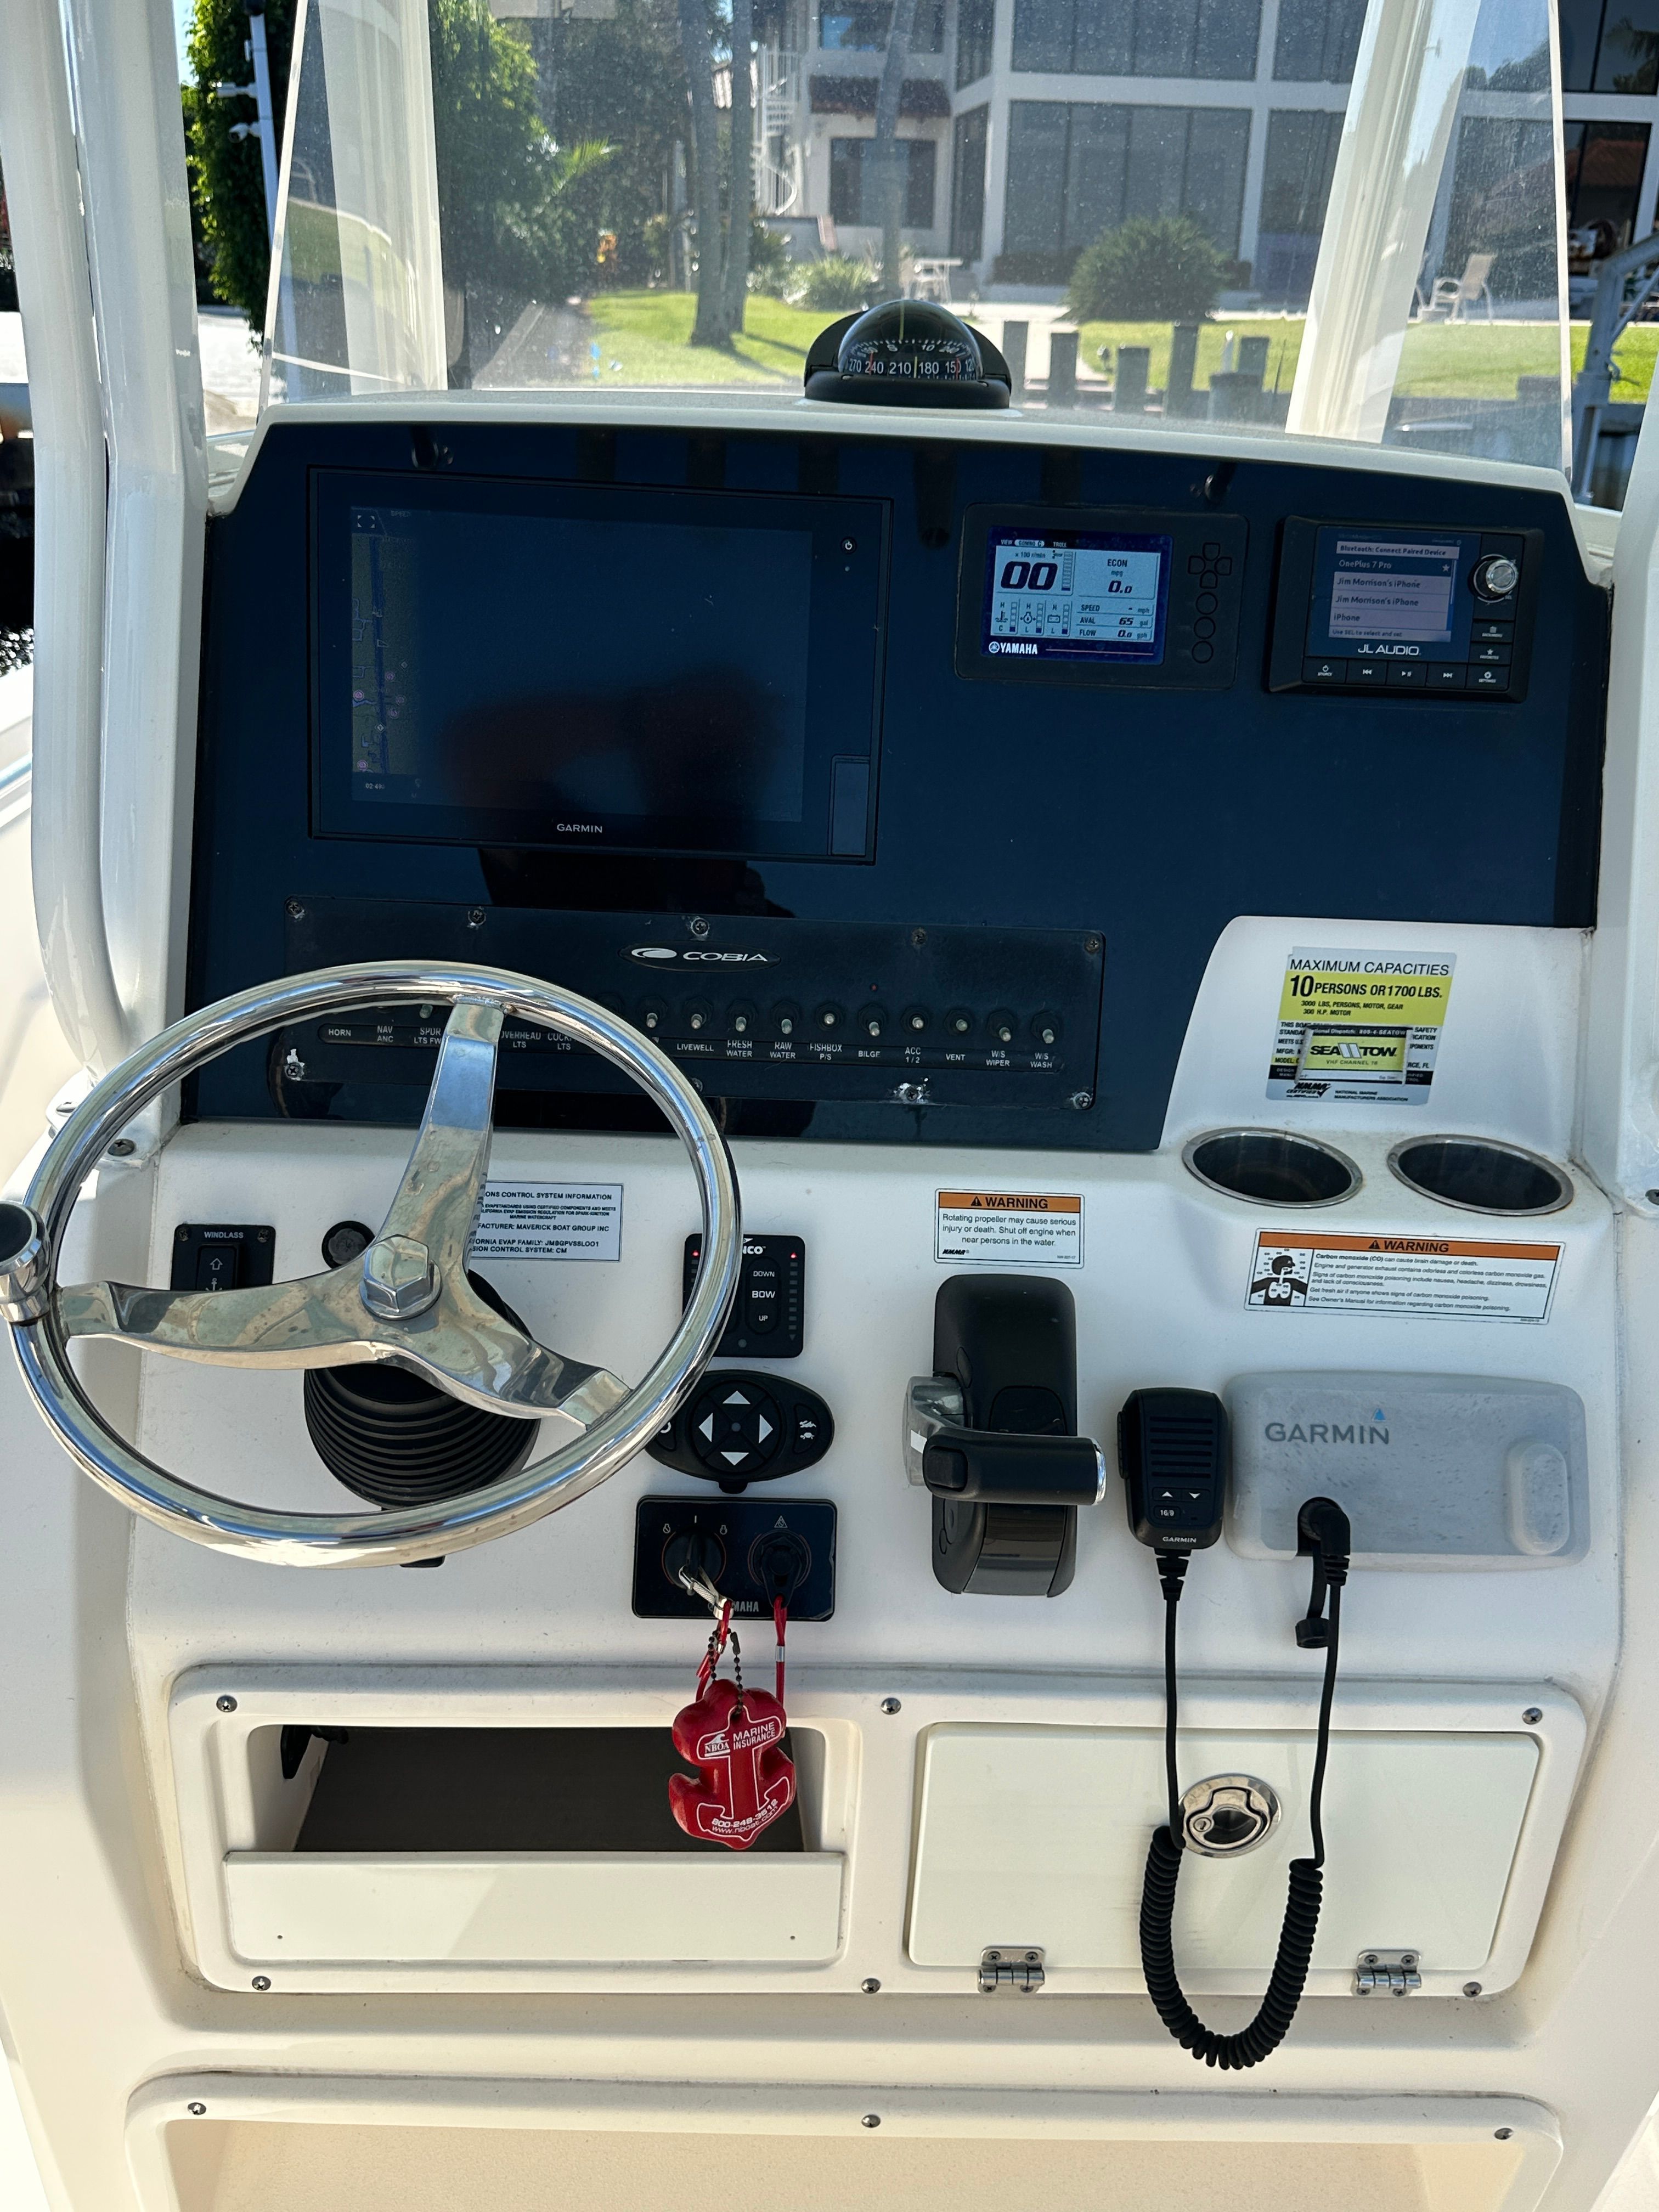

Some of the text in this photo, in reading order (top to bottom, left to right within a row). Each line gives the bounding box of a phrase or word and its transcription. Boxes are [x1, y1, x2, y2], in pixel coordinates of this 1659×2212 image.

[849, 359, 862, 371] 270
[865, 362, 884, 374] 240
[889, 363, 911, 374] 210
[919, 362, 939, 374] 180
[945, 362, 961, 374] 150
[1107, 559, 1127, 567] ECON
[1339, 560, 1370, 568] OnePlus
[1001, 561, 1058, 590] 00
[1108, 580, 1132, 593] 0.0
[1352, 578, 1392, 586] Morrison's
[1351, 596, 1391, 605] Morrison's
[1119, 617, 1133, 625] 65
[1334, 613, 1361, 621] iPhone
[1000, 642, 1038, 655] YAMAHA
[1358, 645, 1420, 656] JL AUDIO
[556, 823, 603, 833] GARMIN
[683, 952, 768, 962] COBIA
[1290, 959, 1449, 975] MAXIMUM CAPACITIES
[1290, 975, 1442, 998] 10 PERSONS OR 1700 LBS.
[377, 1025, 393, 1034] NAV
[548, 1034, 572, 1042] COCK
[727, 1040, 752, 1049] FRESH
[809, 1044, 842, 1052] FISHBOX
[1310, 1046, 1395, 1056] SEA TOW
[985, 1197, 1048, 1209] WARNING
[943, 1214, 973, 1223] Rotating
[943, 1224, 962, 1234] injury
[1029, 1228, 1054, 1237] engine
[1384, 1241, 1449, 1252] WARNING
[752, 1290, 776, 1299] BOW
[1265, 1423, 1390, 1444] GARMIN
[735, 1601, 759, 1612] MAHA
[733, 1722, 775, 1741] MARINE
[733, 1729, 776, 1750] INSURANCE
[704, 1742, 730, 1753] NBOA
